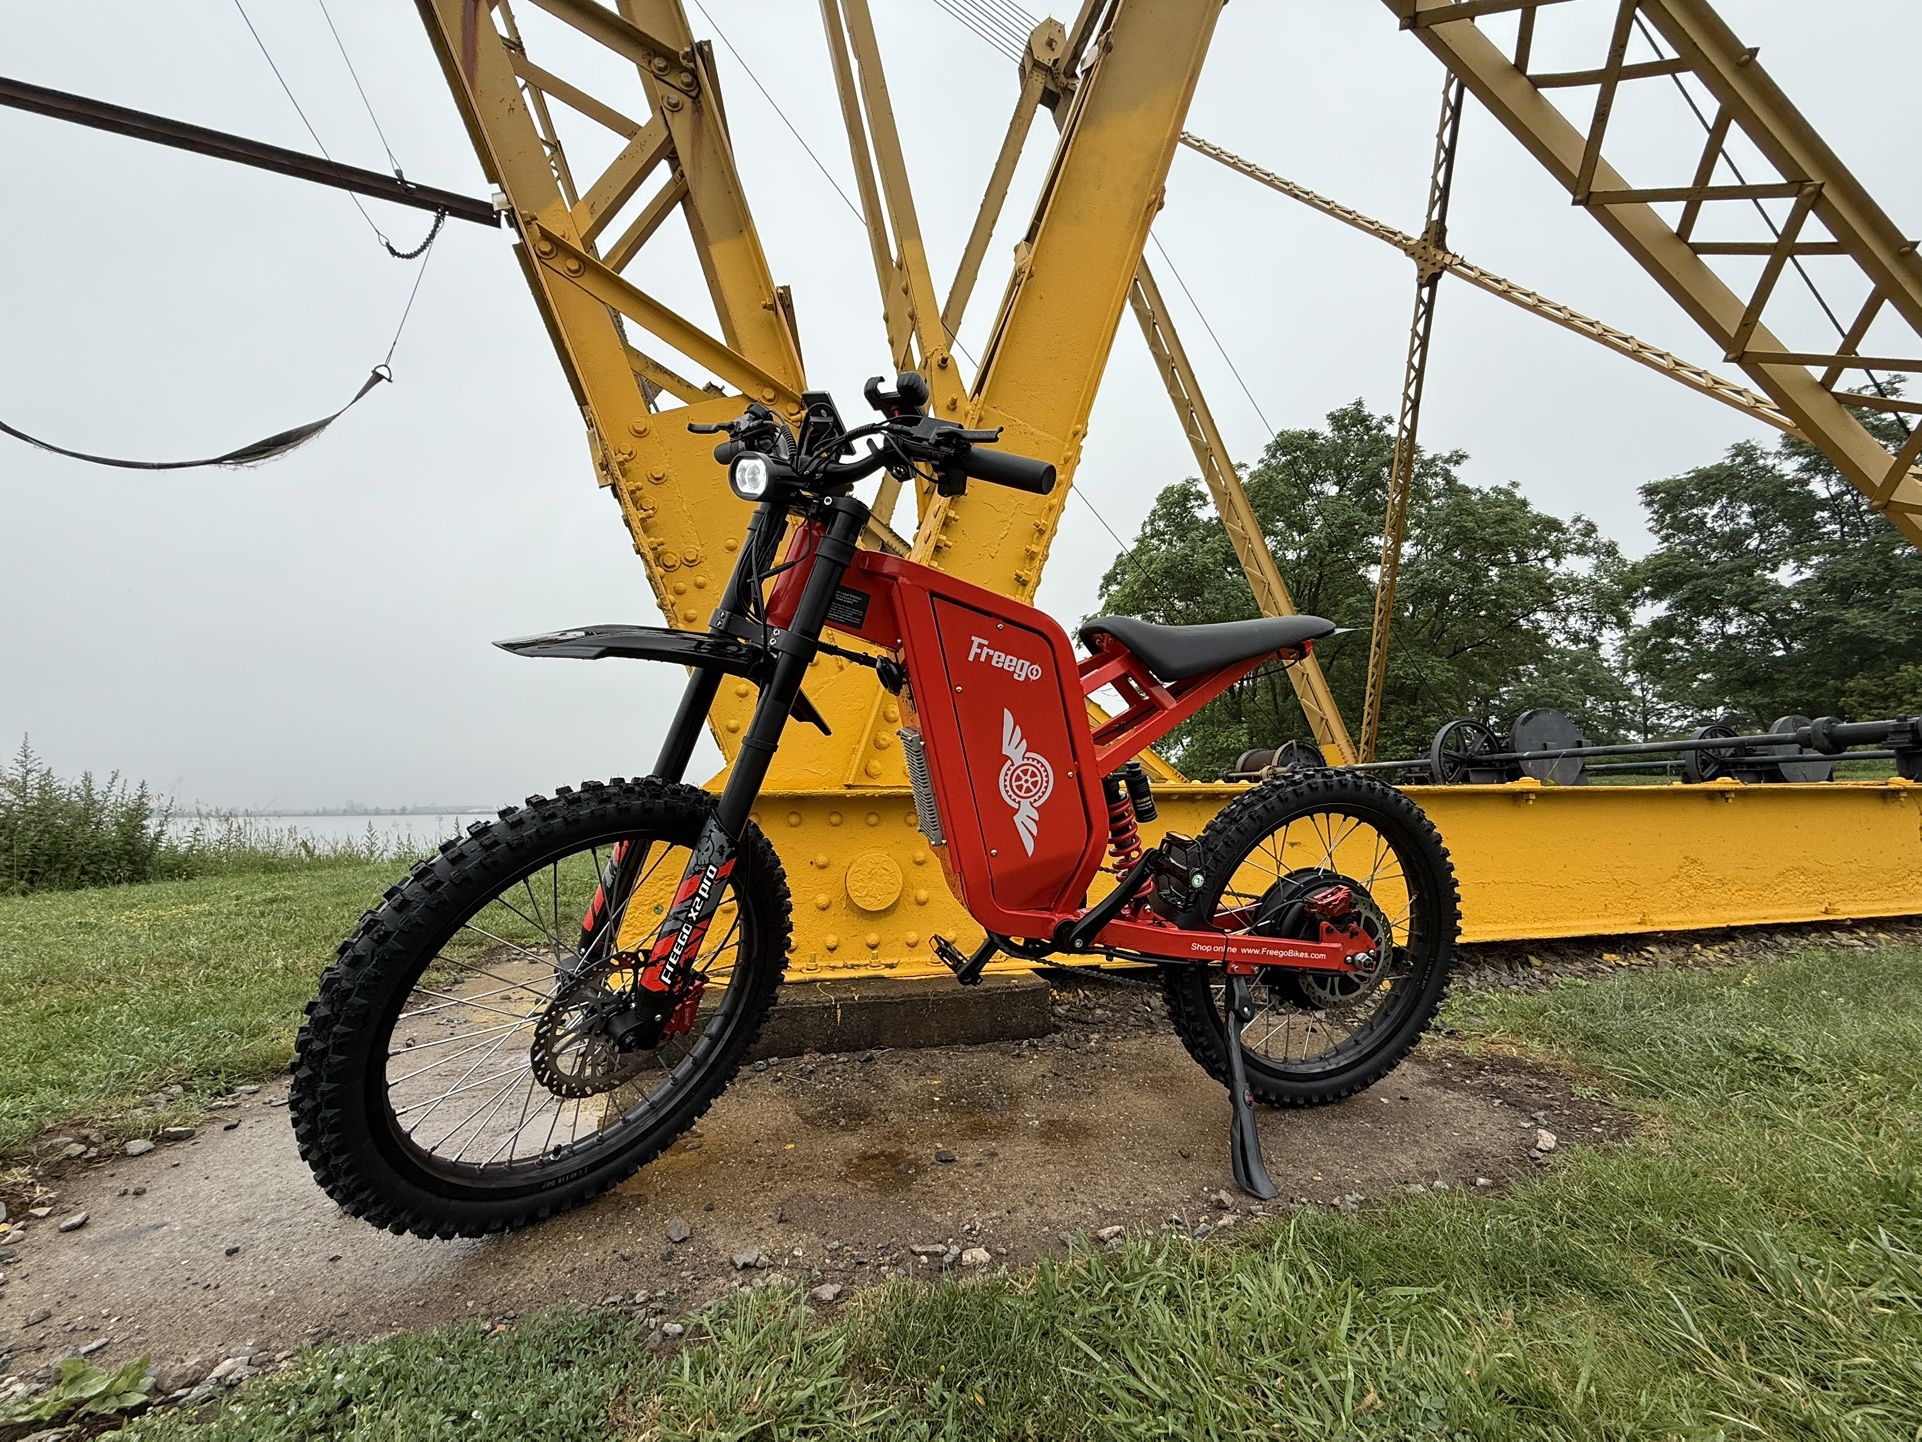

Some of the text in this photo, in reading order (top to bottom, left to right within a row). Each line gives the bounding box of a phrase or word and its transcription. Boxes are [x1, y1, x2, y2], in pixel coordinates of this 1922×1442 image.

[968, 635, 1042, 682] Freego
[1191, 942, 1327, 960] Shop onlne www.FreegoBikes.com
